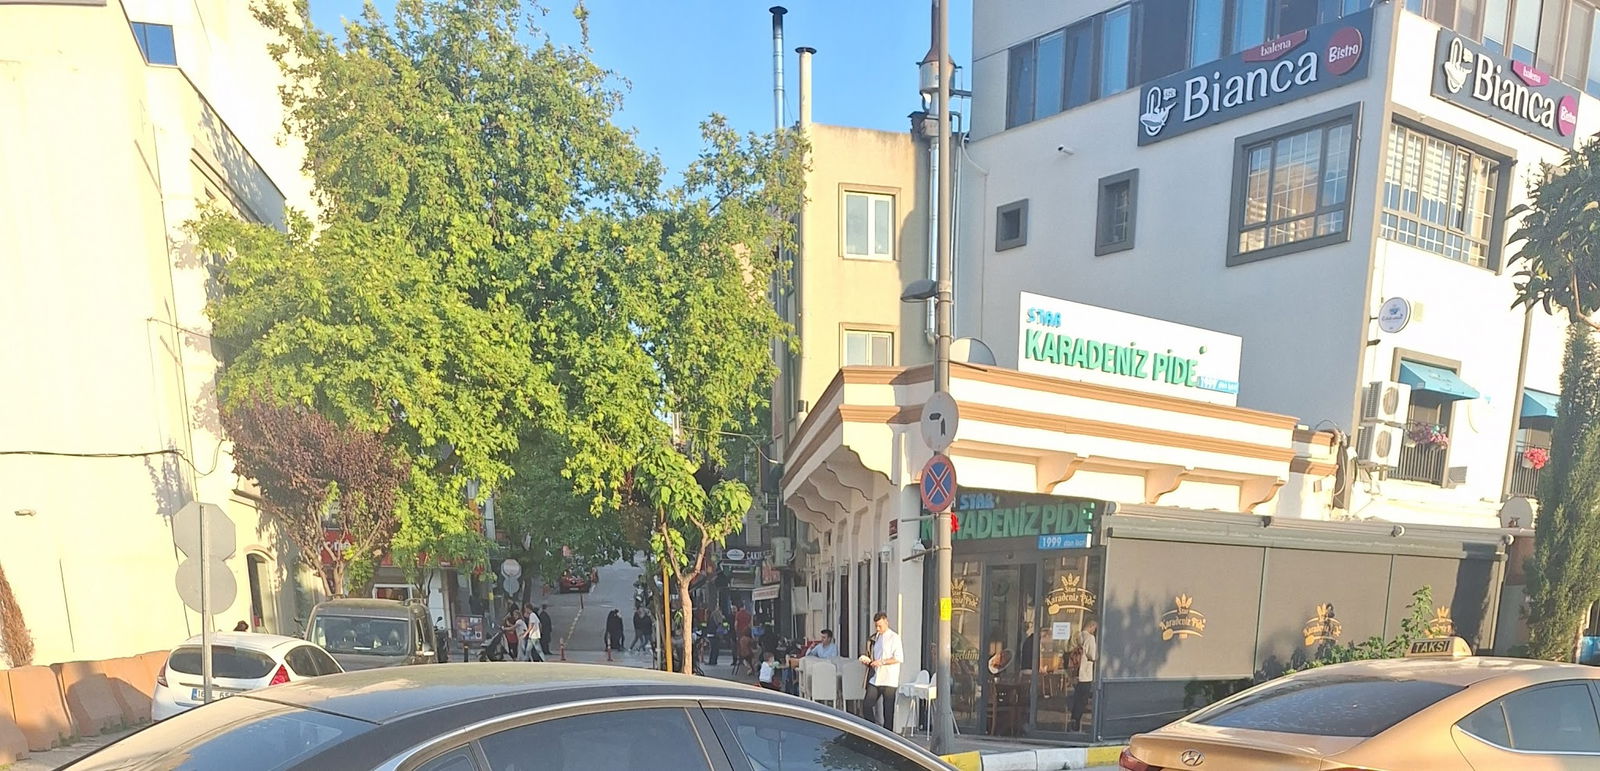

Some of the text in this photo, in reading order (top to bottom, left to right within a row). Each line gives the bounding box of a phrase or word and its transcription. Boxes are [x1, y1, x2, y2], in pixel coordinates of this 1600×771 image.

[1260, 38, 1292, 57] balena
[1328, 43, 1359, 63] Bistro
[1183, 51, 1318, 123] Bianca
[1473, 53, 1556, 130] Bianca
[1025, 328, 1198, 388] KARADENİZ PİDE
[1042, 537, 1062, 548] 1999
[1415, 640, 1449, 653] TAKSI
